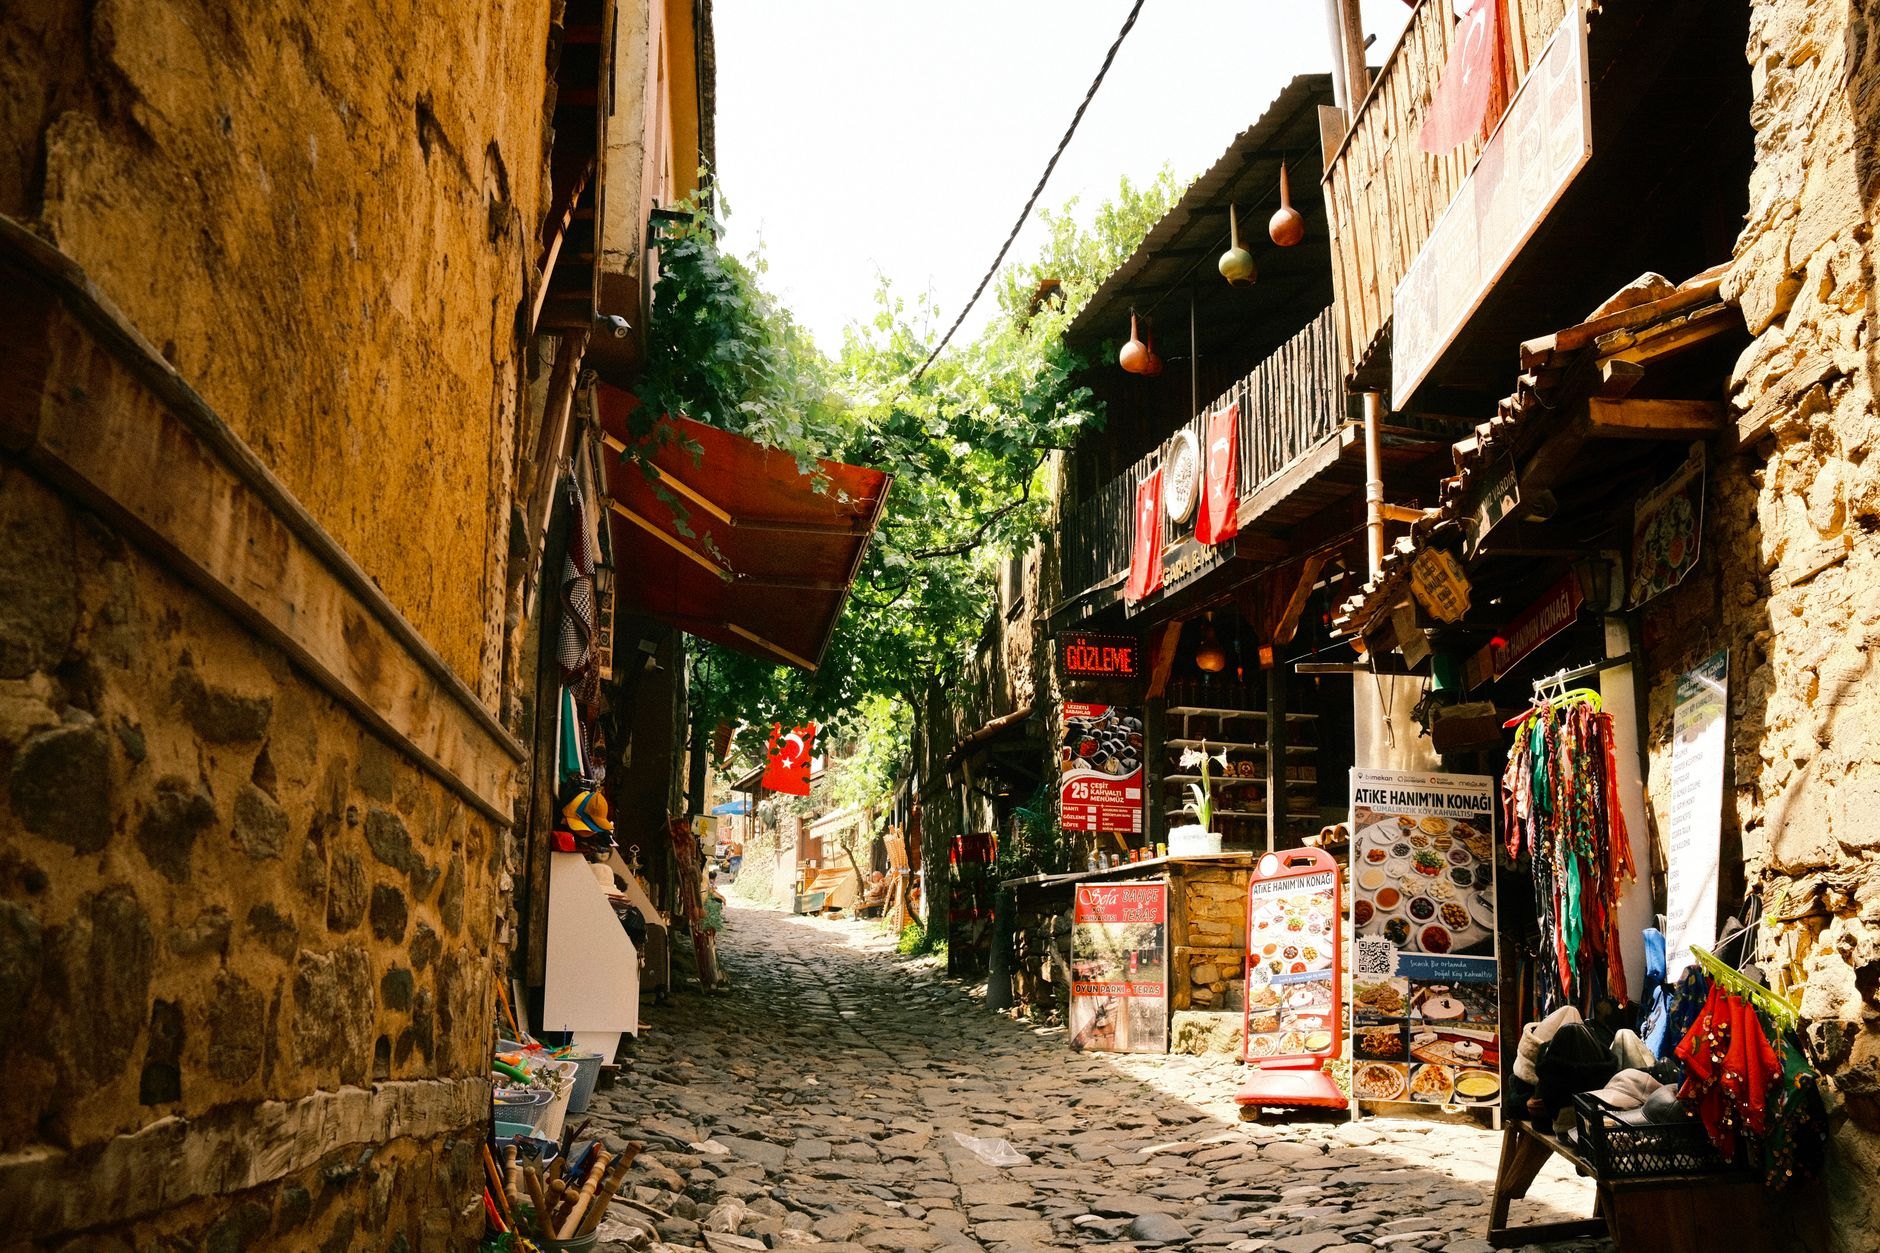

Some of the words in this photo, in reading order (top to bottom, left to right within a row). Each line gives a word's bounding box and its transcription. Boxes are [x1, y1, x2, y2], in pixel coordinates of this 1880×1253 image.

[1492, 470, 1516, 501] VARDIR
[1163, 556, 1191, 587] GARA
[1066, 639, 1132, 672] GÖZLEME
[1071, 782, 1089, 799] 25
[1090, 781, 1109, 789] ÇEŞİT
[1090, 789, 1122, 797] KAHVALTI
[1090, 795, 1124, 803] MENÜMÜZ
[1447, 793, 1491, 811] KONAĞI
[1372, 805, 1417, 814] CUMALIKIZIK
[1418, 806, 1432, 816] KÖY
[1433, 808, 1474, 818] KAHVALTISI
[1306, 873, 1333, 887] KONAĞI
[1079, 888, 1119, 905] Sofa
[1122, 888, 1159, 905] BAHÇE
[1122, 908, 1157, 921] TERAS
[1434, 970, 1450, 978] Doğal
[1075, 985, 1098, 993] OYUN
[1100, 985, 1124, 993] PARKI
[1133, 985, 1160, 994] TERAS
